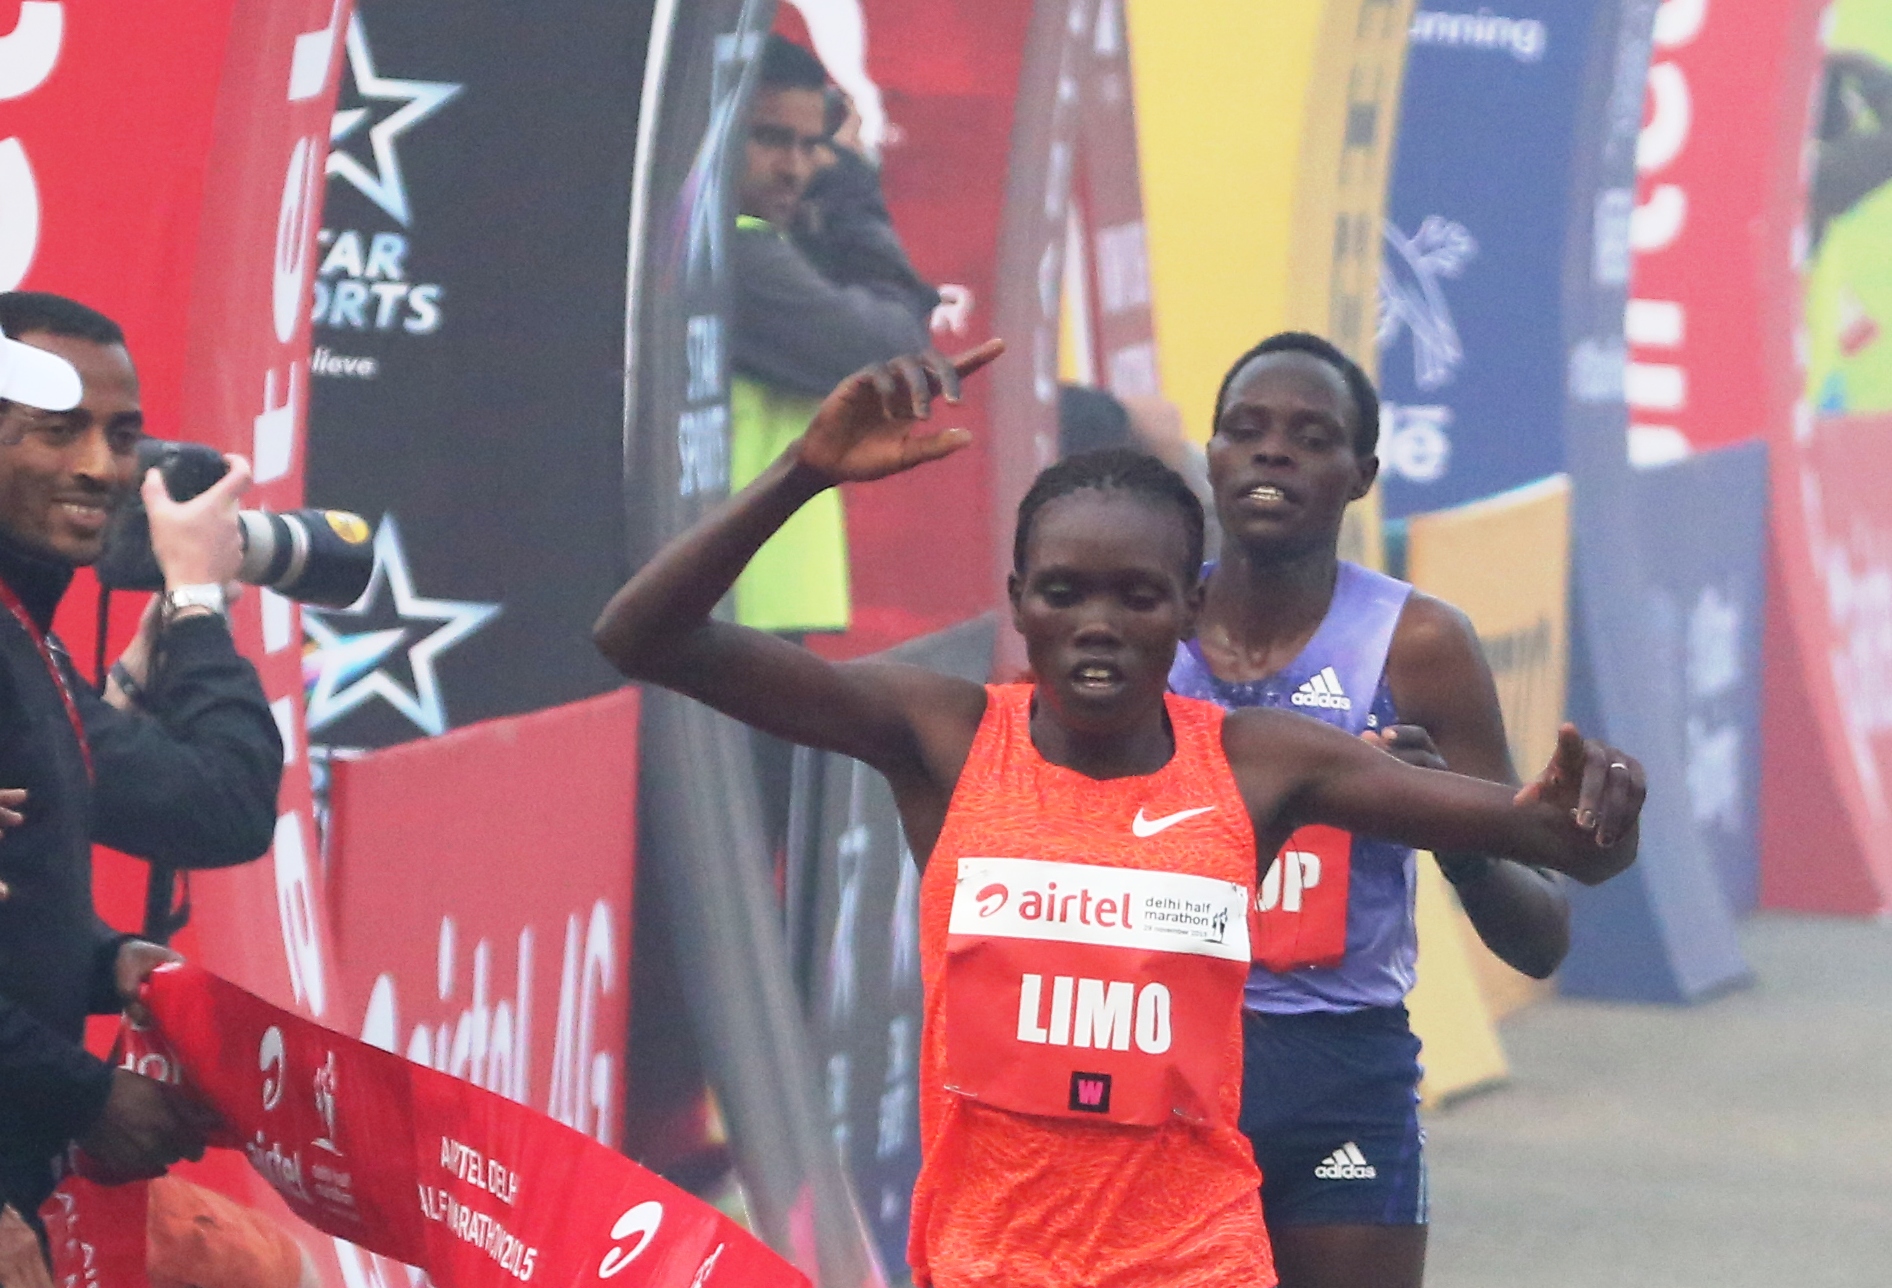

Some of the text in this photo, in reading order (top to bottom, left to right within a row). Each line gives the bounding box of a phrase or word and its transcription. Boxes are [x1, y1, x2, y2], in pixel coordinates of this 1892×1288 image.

[1290, 692, 1351, 711] adidas
[1018, 881, 1134, 930] airtel
[1145, 897, 1211, 914] delhi half
[1144, 911, 1209, 926] marathon
[1016, 973, 1173, 1055] LIMO
[1314, 1164, 1377, 1180] adidas
